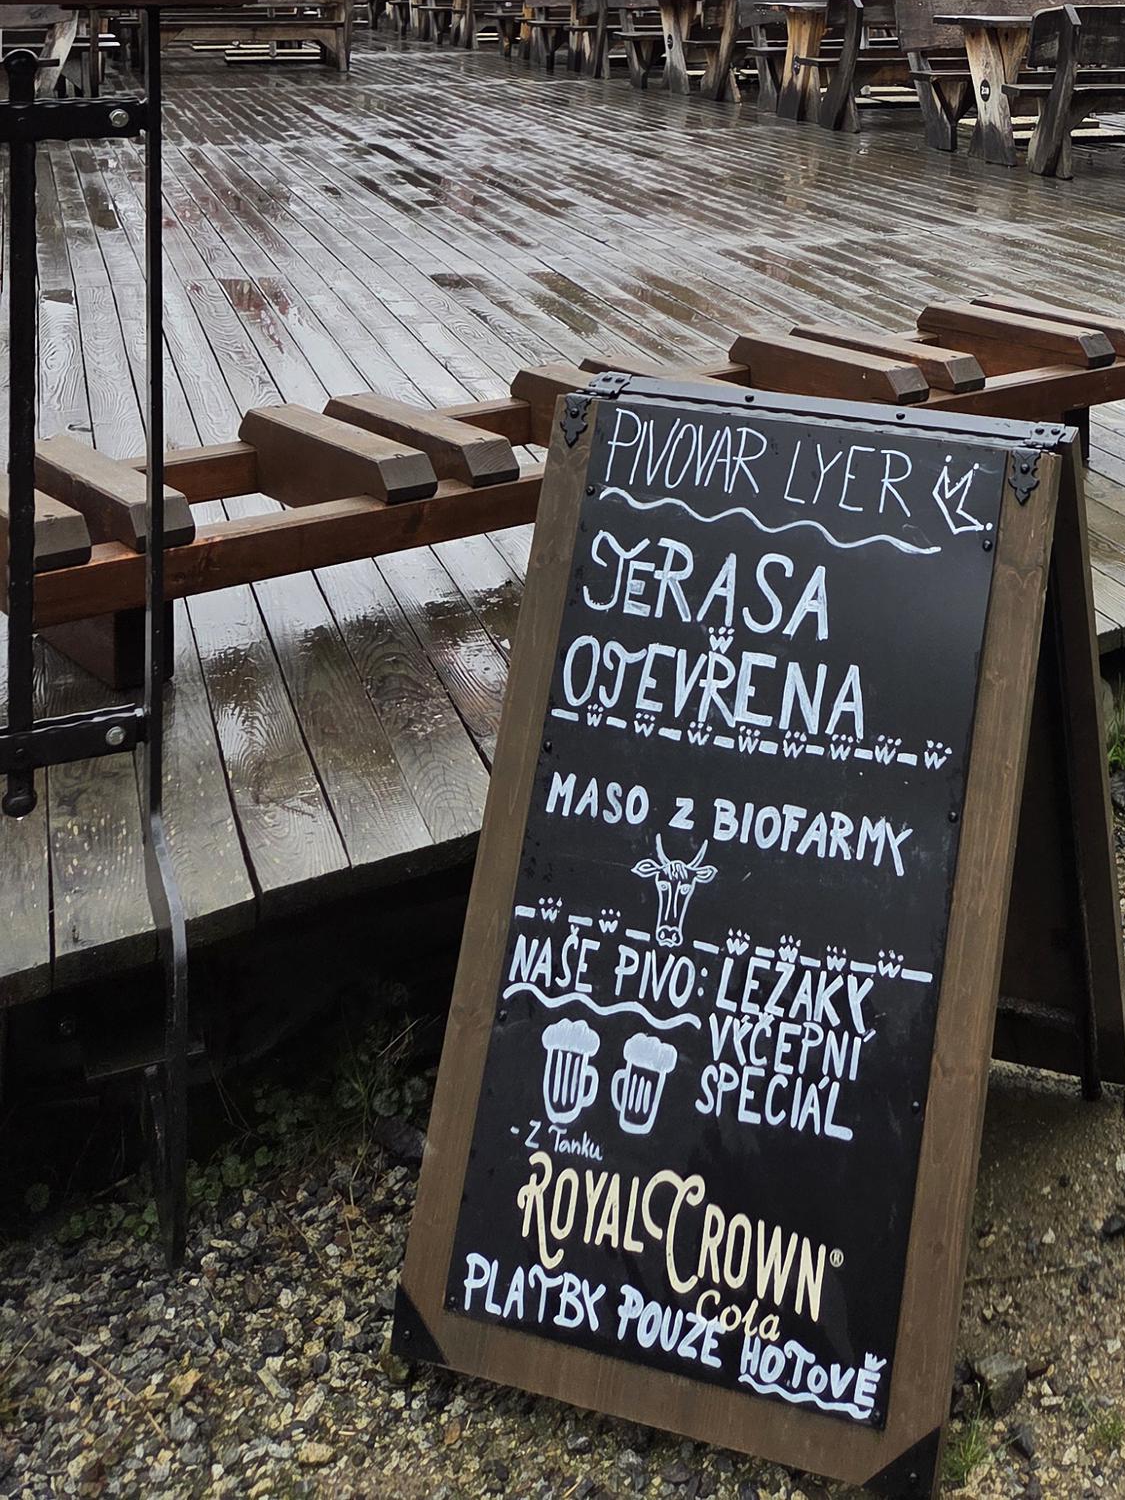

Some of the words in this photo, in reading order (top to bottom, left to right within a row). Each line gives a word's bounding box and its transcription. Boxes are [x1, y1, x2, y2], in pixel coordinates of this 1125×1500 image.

[603, 408, 767, 494] PIVOVAR
[783, 440, 912, 518] LYER
[583, 529, 830, 641] TERASA
[545, 772, 650, 826] MASO
[712, 799, 913, 877] BIOFARMY
[507, 926, 600, 993] NAŠE
[614, 944, 708, 1008] PIVO:
[548, 1126, 604, 1161] Tanku
[695, 1062, 854, 1141] SPECIÁL
[517, 1151, 644, 1269] ROYAL
[464, 1253, 606, 1331] PLATBY
[617, 1284, 726, 1367] POUZE
[696, 1289, 781, 1341] Cola
